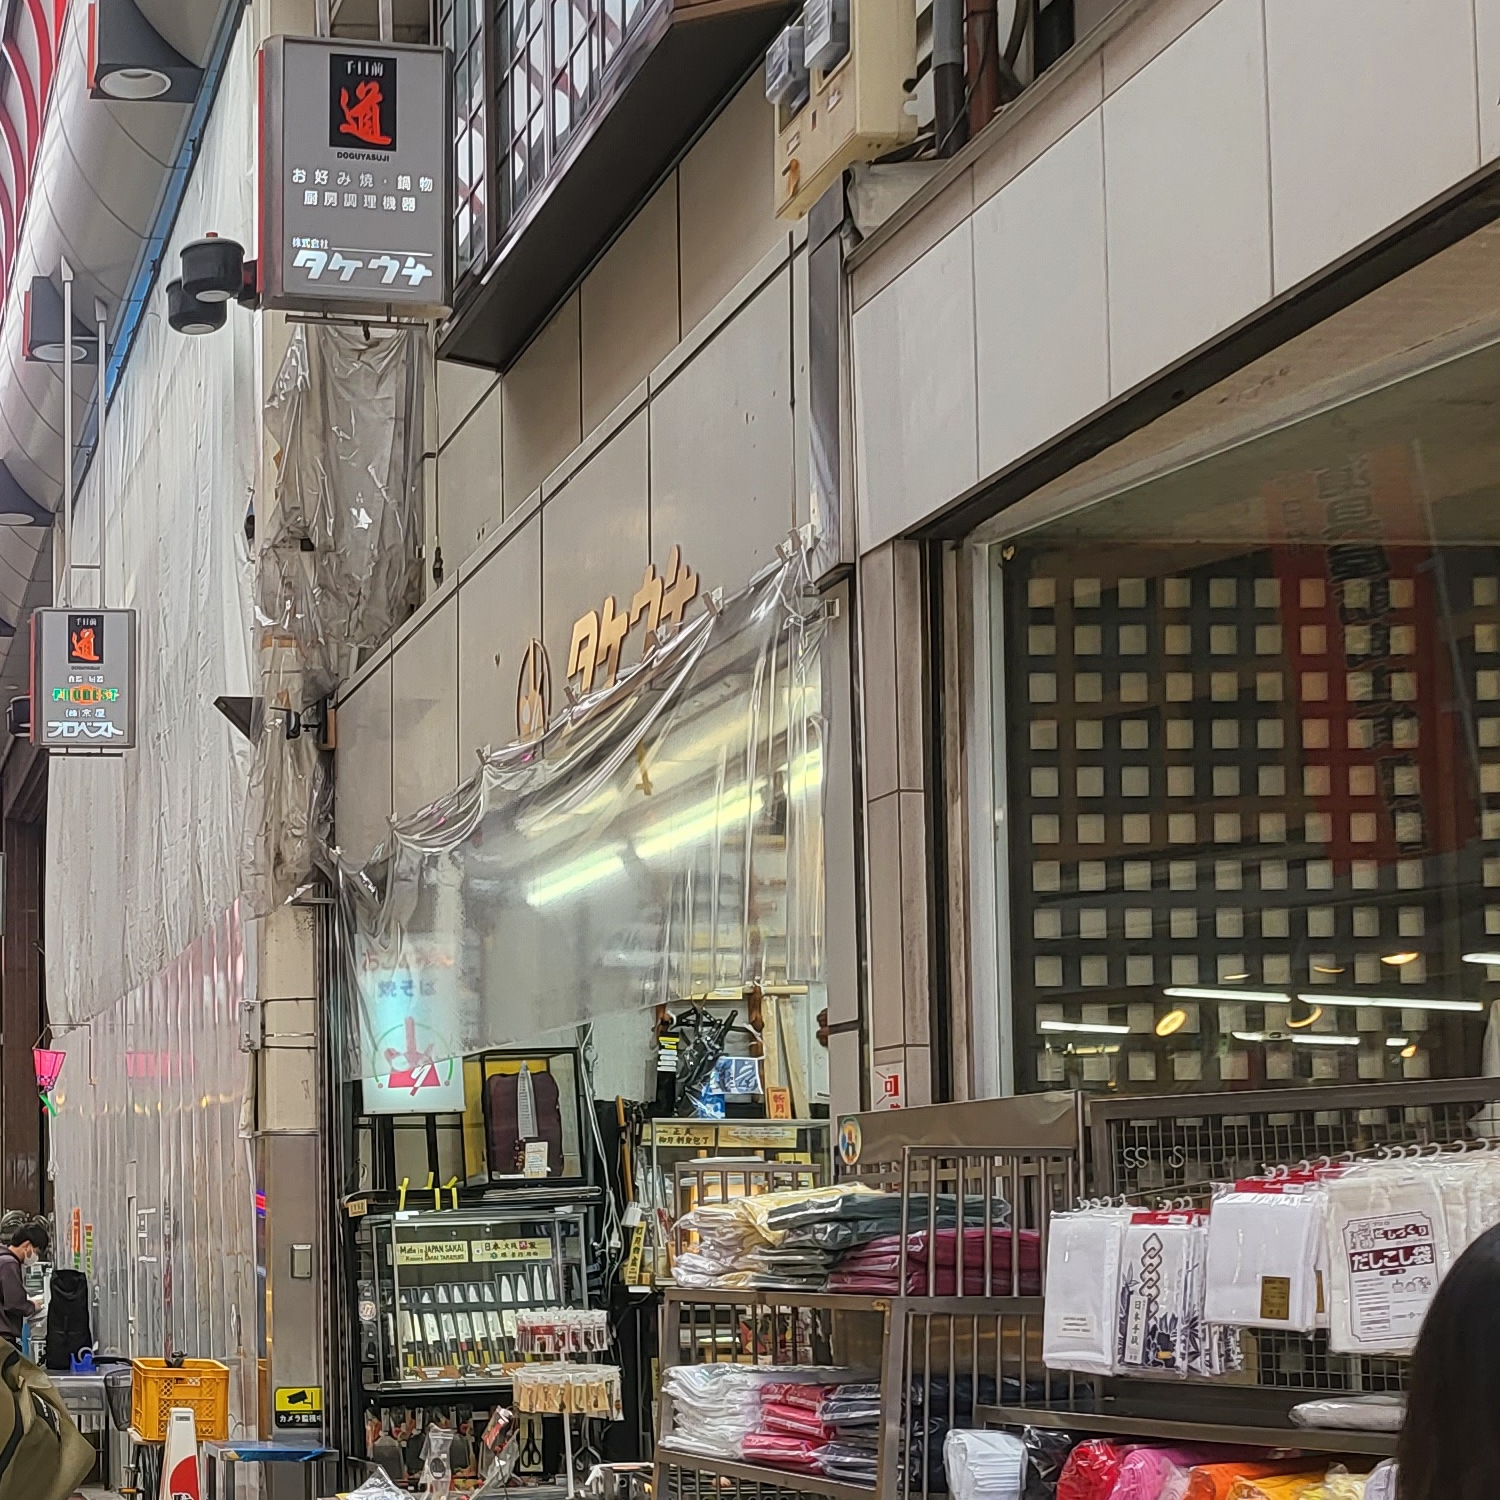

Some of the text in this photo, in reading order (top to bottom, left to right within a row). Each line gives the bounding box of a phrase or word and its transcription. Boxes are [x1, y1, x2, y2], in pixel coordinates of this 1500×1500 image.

[339, 80, 392, 145] 道
[336, 151, 390, 163] DOGUYASUJI
[303, 190, 416, 212] 厨房調理機器
[291, 236, 329, 250] 株式会社
[292, 249, 433, 286] タケウチ
[567, 544, 699, 694] タケウチ
[71, 627, 100, 661] 道
[47, 721, 124, 738] プロベスト
[424, 1245, 444, 1255] JAPAN
[445, 1244, 465, 1253] SAKAI
[1351, 1246, 1433, 1271] だしこし袋
